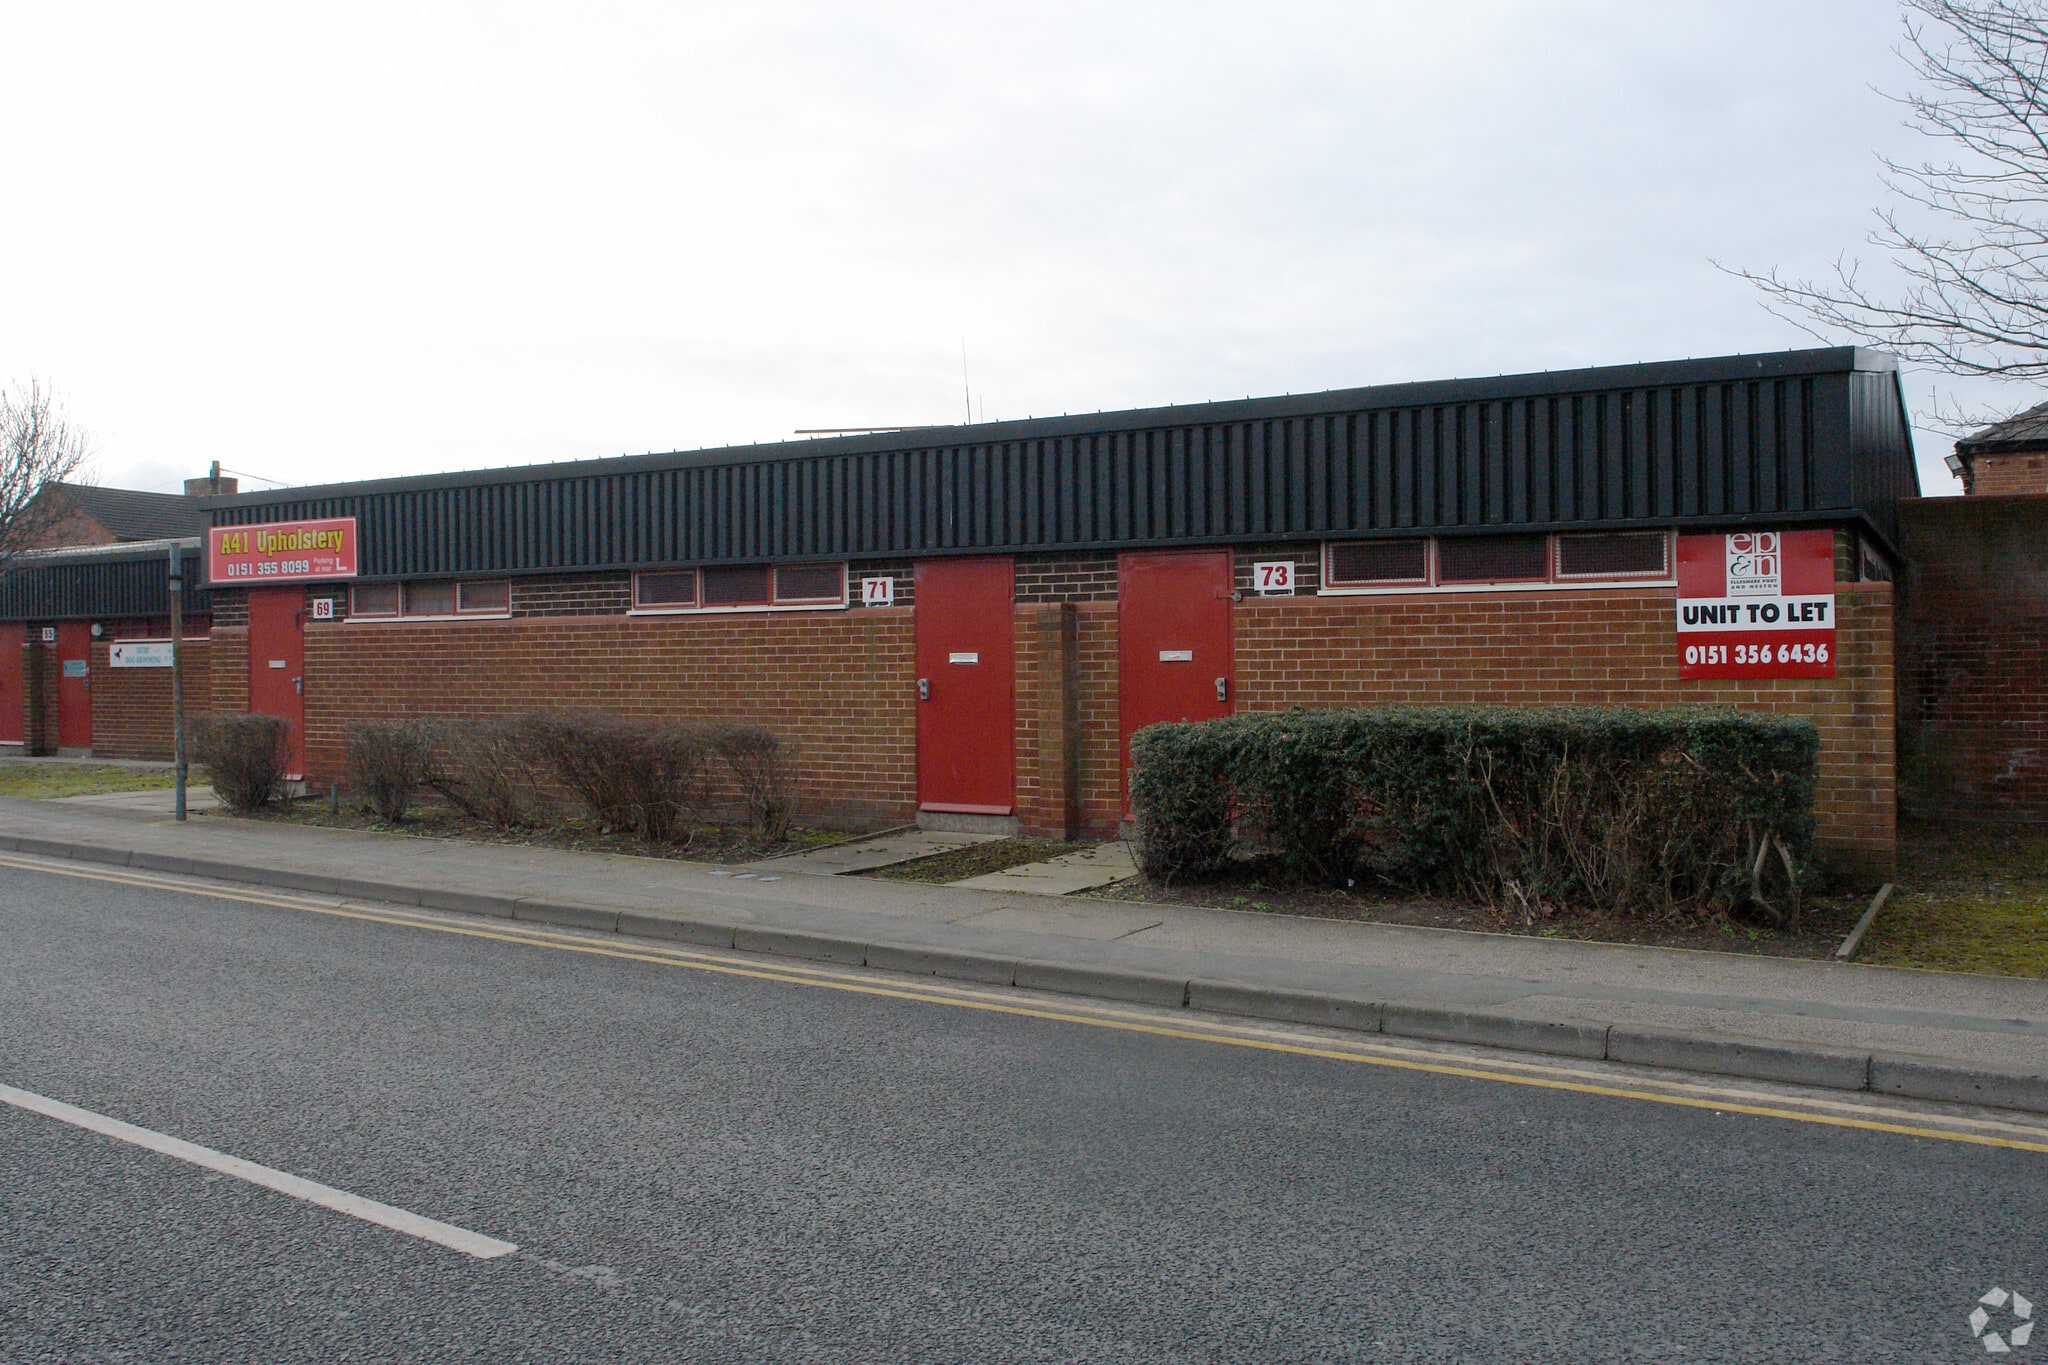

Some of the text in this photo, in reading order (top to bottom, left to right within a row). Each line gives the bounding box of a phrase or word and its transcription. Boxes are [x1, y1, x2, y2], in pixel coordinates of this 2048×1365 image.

[221, 527, 344, 558] A41 Upholstery
[227, 559, 310, 576] 0151 355 8099
[313, 557, 334, 565] Parking
[1261, 566, 1287, 586] 73
[867, 581, 887, 599] 71
[317, 602, 330, 616] 69
[1683, 602, 1828, 625] UNIT TO LET
[1685, 643, 1829, 665] 0151 356 6436
